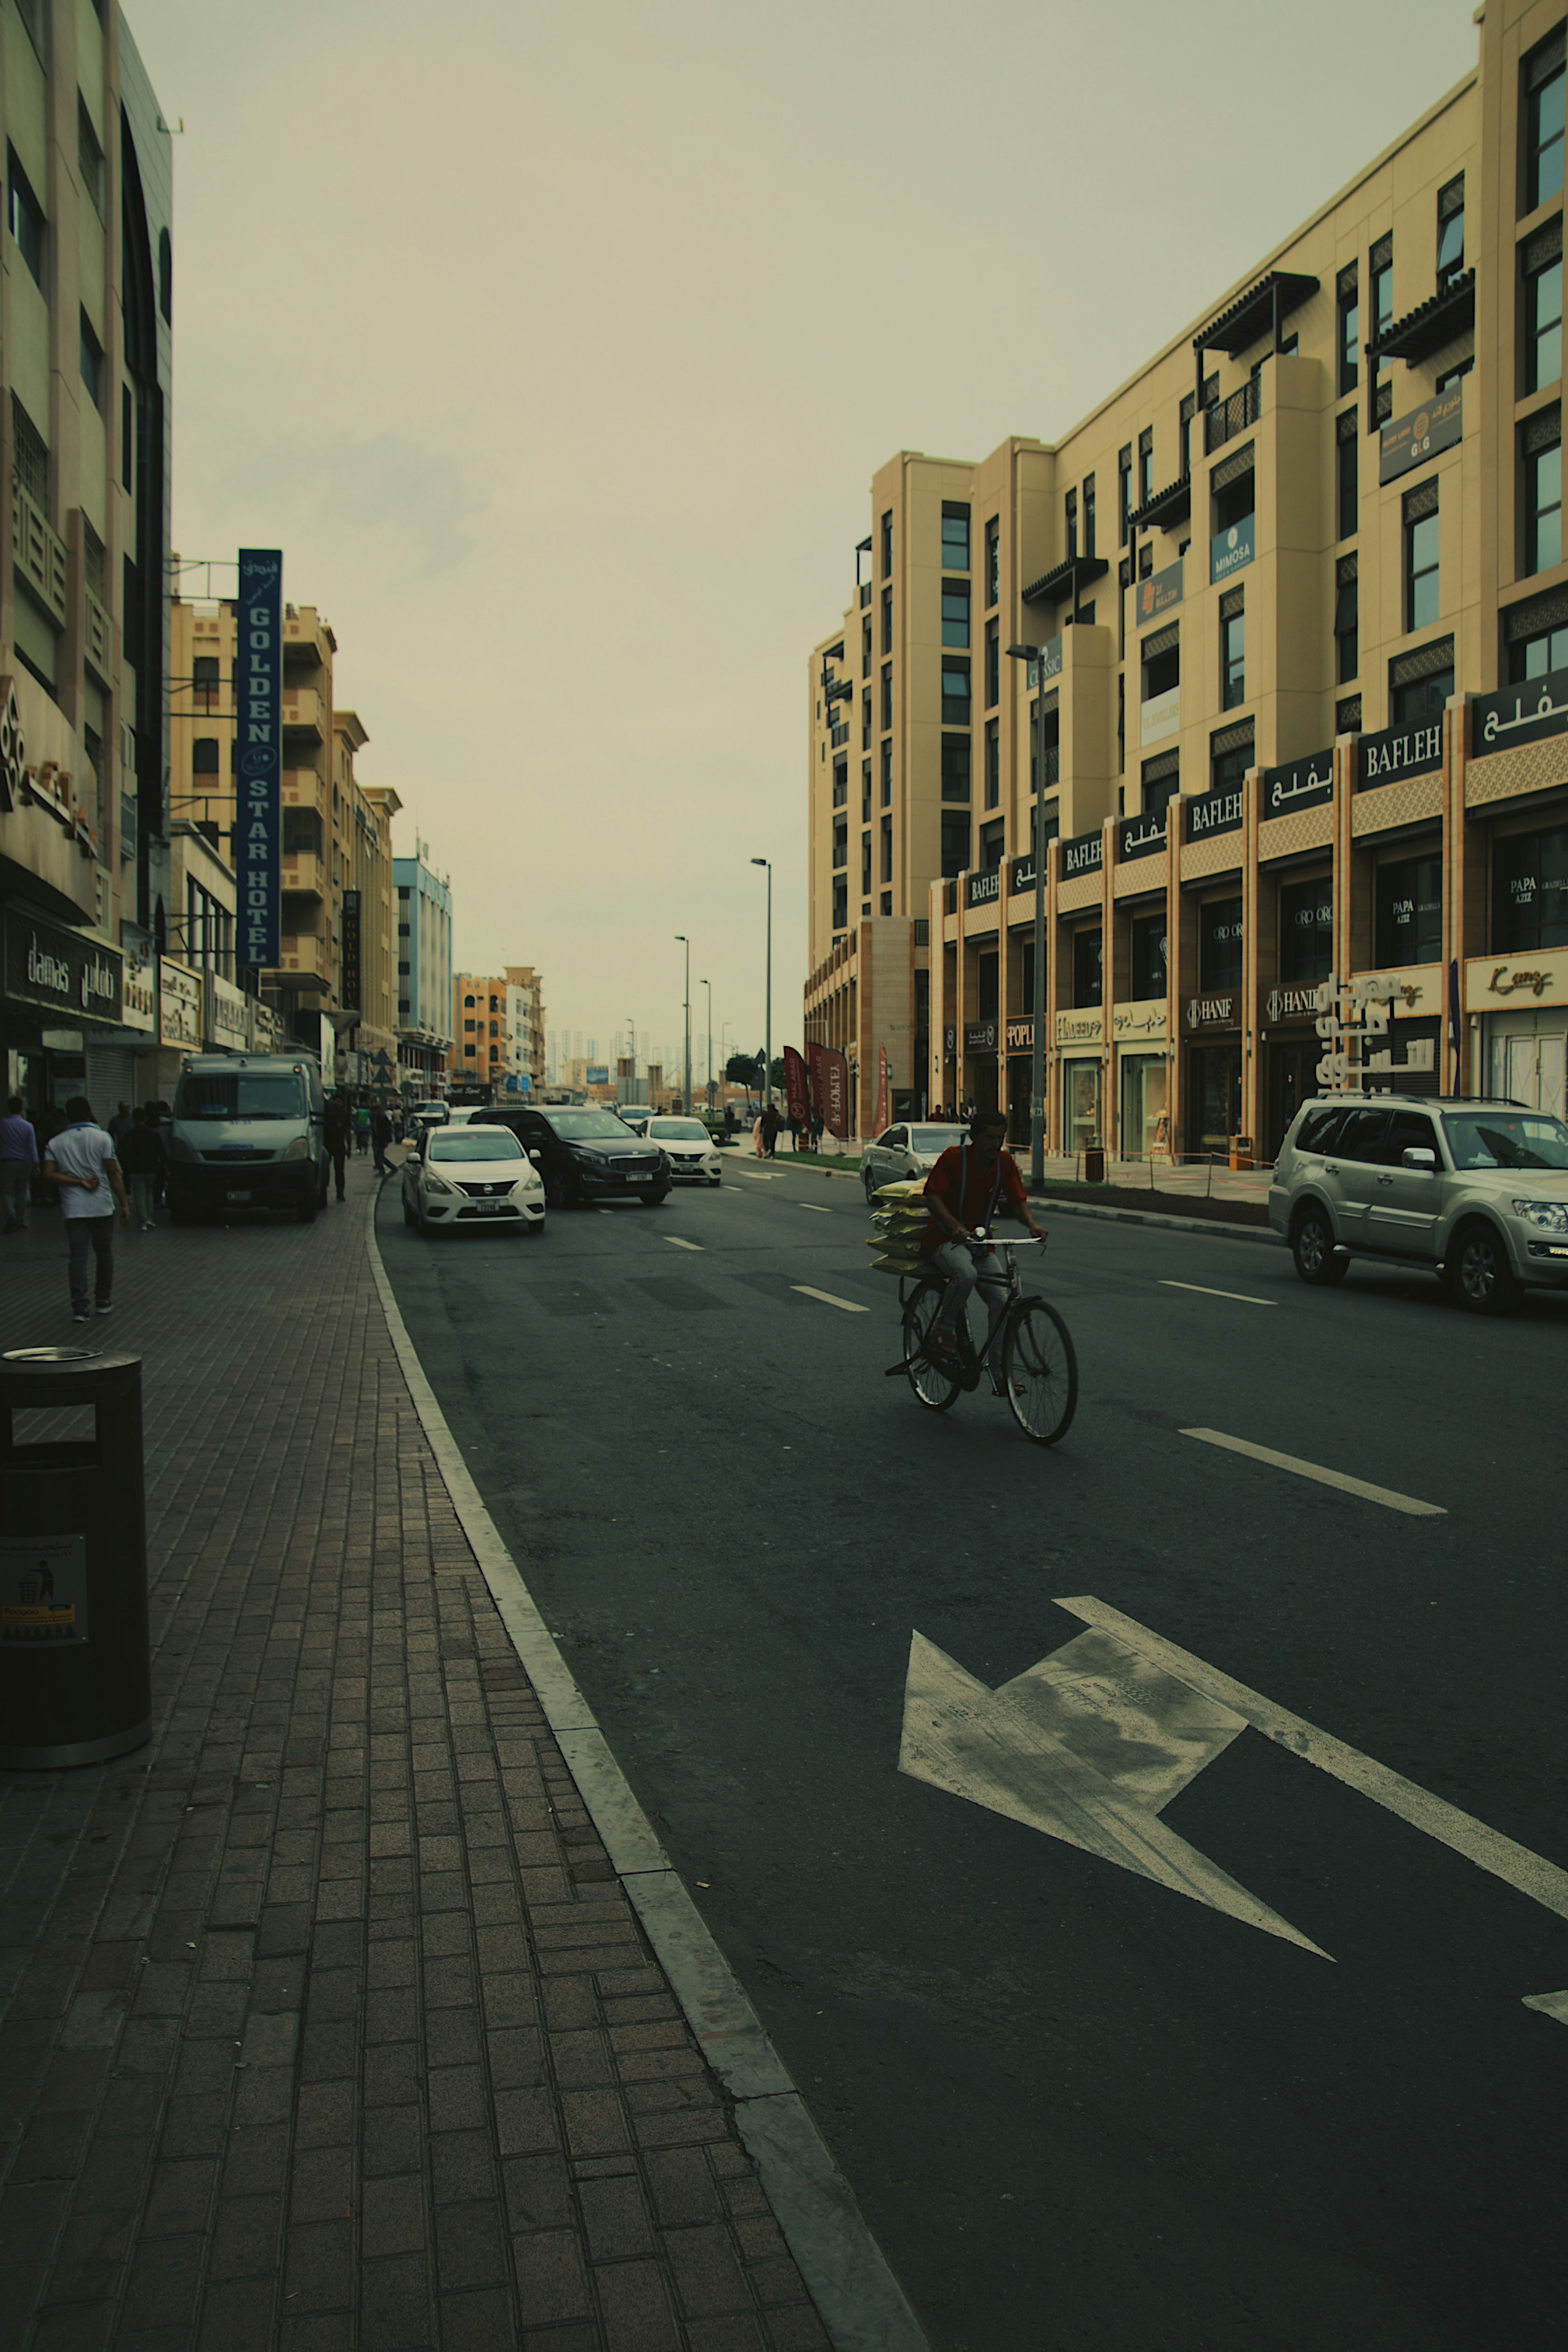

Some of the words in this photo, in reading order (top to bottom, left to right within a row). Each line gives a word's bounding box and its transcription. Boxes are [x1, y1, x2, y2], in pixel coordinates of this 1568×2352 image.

[1411, 436, 1429, 457] GLG
[1216, 543, 1250, 574] MIMOSA
[248, 607, 271, 742] GOLDEN
[1367, 725, 1441, 777] BAFLEH
[248, 780, 269, 860] STAR
[1192, 792, 1242, 832] BAFLEH
[1066, 839, 1102, 871] BAFLEH
[1511, 876, 1537, 894] PAPA
[1515, 892, 1533, 904] AZIZ
[247, 871, 268, 962] HOTEL
[1295, 909, 1313, 926] ORO
[1393, 899, 1414, 914] PAPA
[1397, 913, 1410, 924] AZIZ
[347, 920, 356, 961] GOLD
[28, 930, 69, 993] damas
[346, 970, 356, 1009] HOUS
[1201, 998, 1232, 1020] HANIF
[1007, 1024, 1034, 1047] POPL
[1056, 1017, 1092, 1040] HADEED
[4, 1607, 39, 1616] 800900
